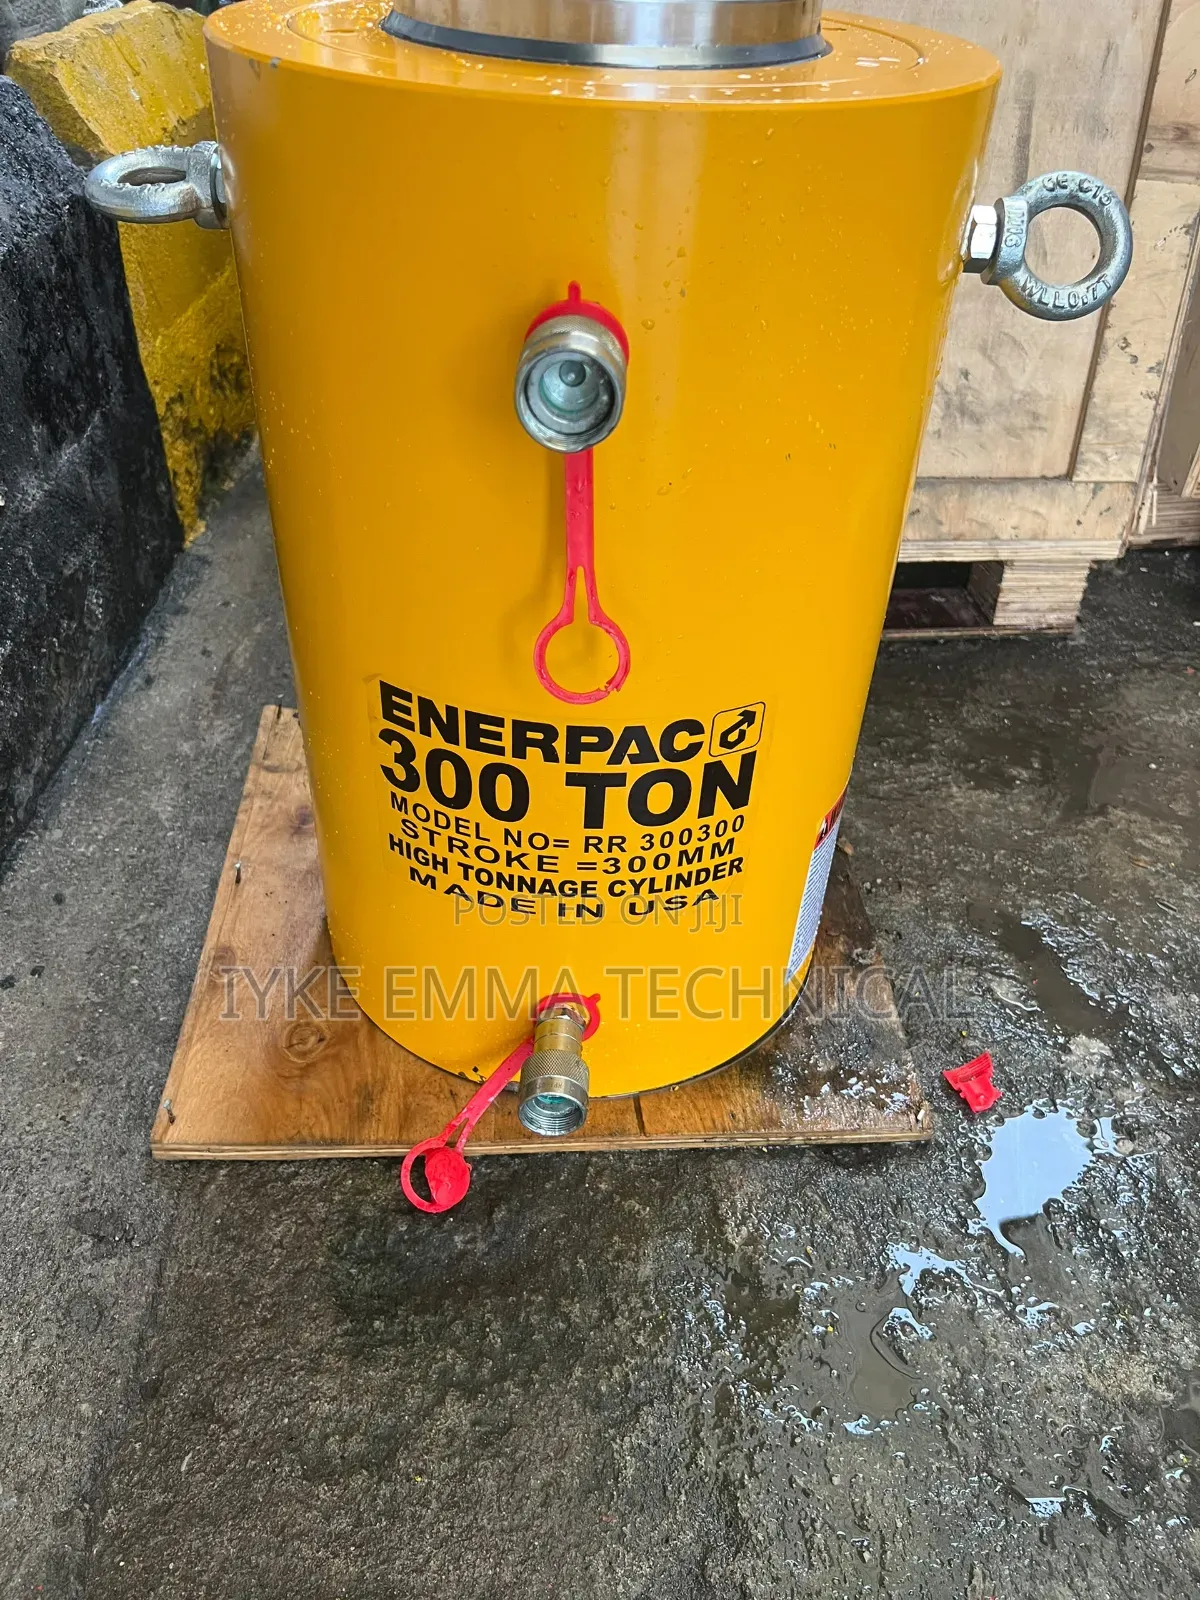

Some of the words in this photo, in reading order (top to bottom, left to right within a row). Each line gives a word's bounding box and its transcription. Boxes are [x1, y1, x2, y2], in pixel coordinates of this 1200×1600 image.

[379, 679, 706, 766] ENERPAC
[378, 727, 531, 823] 300
[565, 750, 756, 830] TON
[390, 790, 491, 843] MODEL
[503, 827, 570, 851] NO=
[583, 835, 628, 854] RR
[639, 814, 746, 852] 300300
[401, 818, 560, 874] STROKE
[388, 832, 449, 875] HIGH
[456, 861, 599, 898] TONNAGE
[607, 856, 745, 898] CYLINDER
[409, 866, 537, 915] MADE
[557, 902, 604, 919] IN
[627, 888, 720, 916] USA
